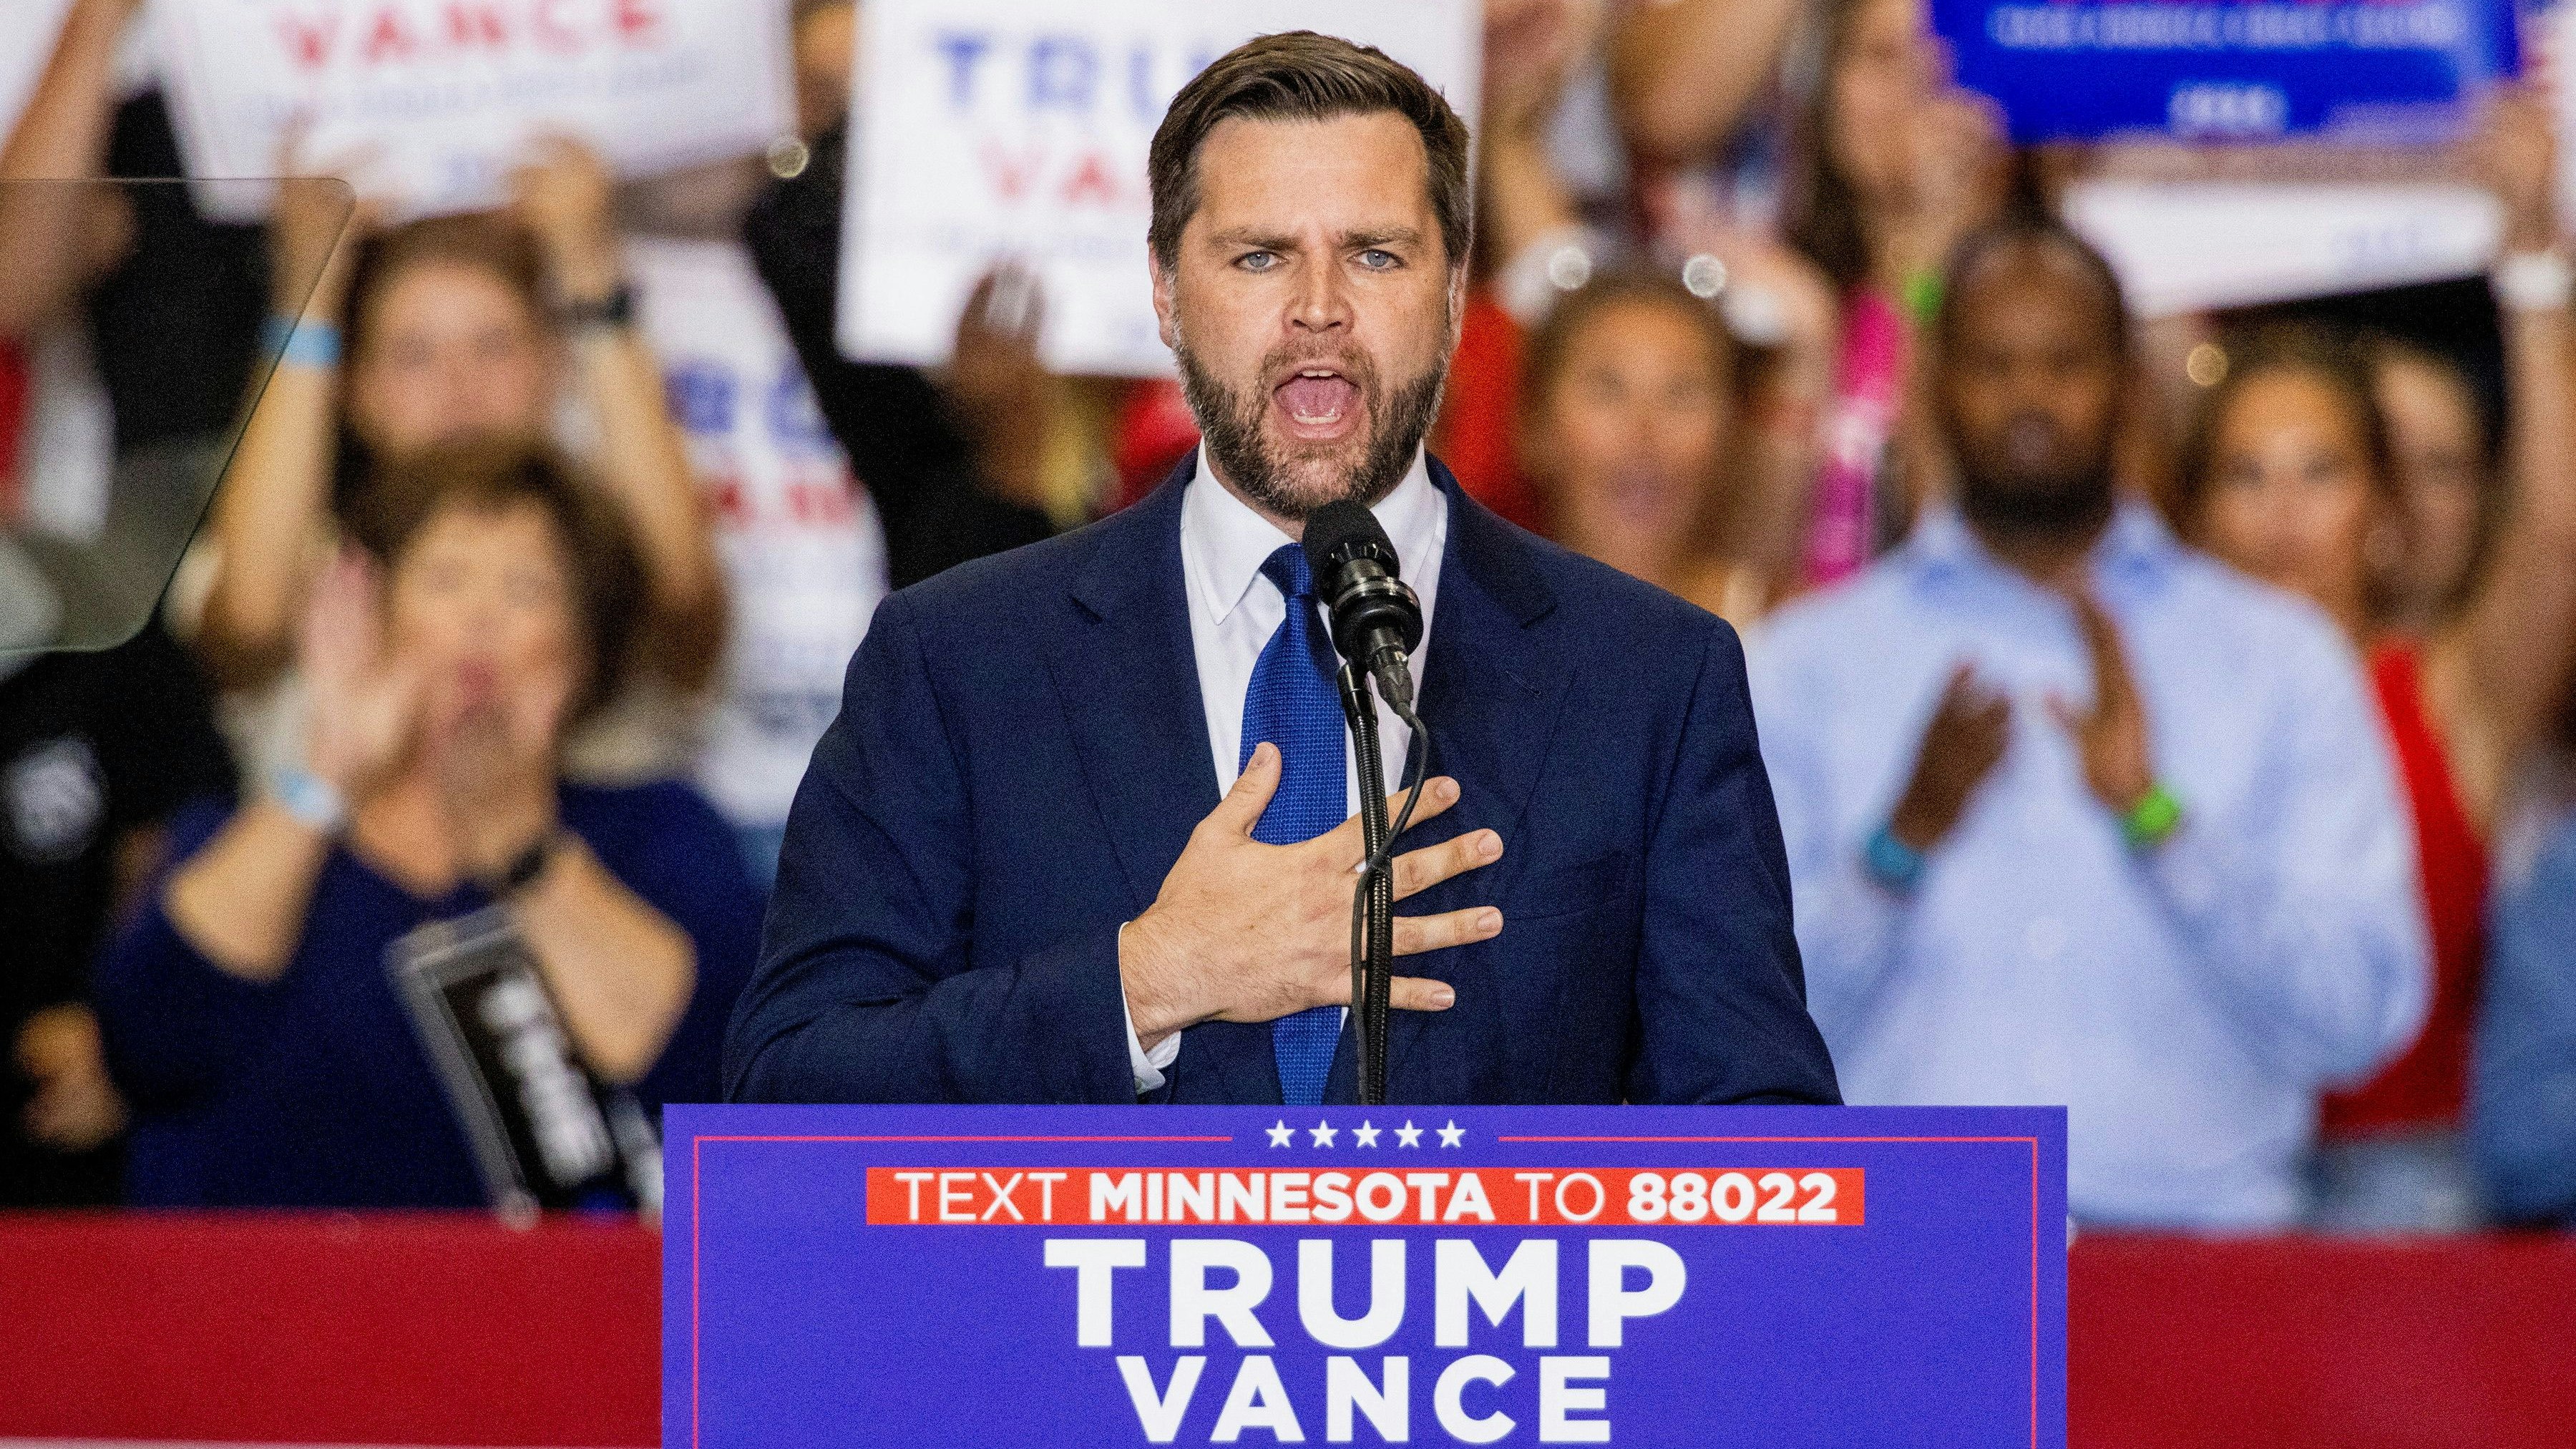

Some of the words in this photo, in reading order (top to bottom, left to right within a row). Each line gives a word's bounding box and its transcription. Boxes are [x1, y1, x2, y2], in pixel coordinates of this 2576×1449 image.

[930, 31, 1216, 119] TRU
[894, 1172, 1067, 1222] TEXT
[1089, 1171, 1496, 1223] MINNESOTA
[1514, 1172, 1605, 1223] TO
[1627, 1171, 1838, 1223] 88022
[1044, 1239, 1687, 1349] TRUMP
[1116, 1355, 1611, 1443] VANCE
